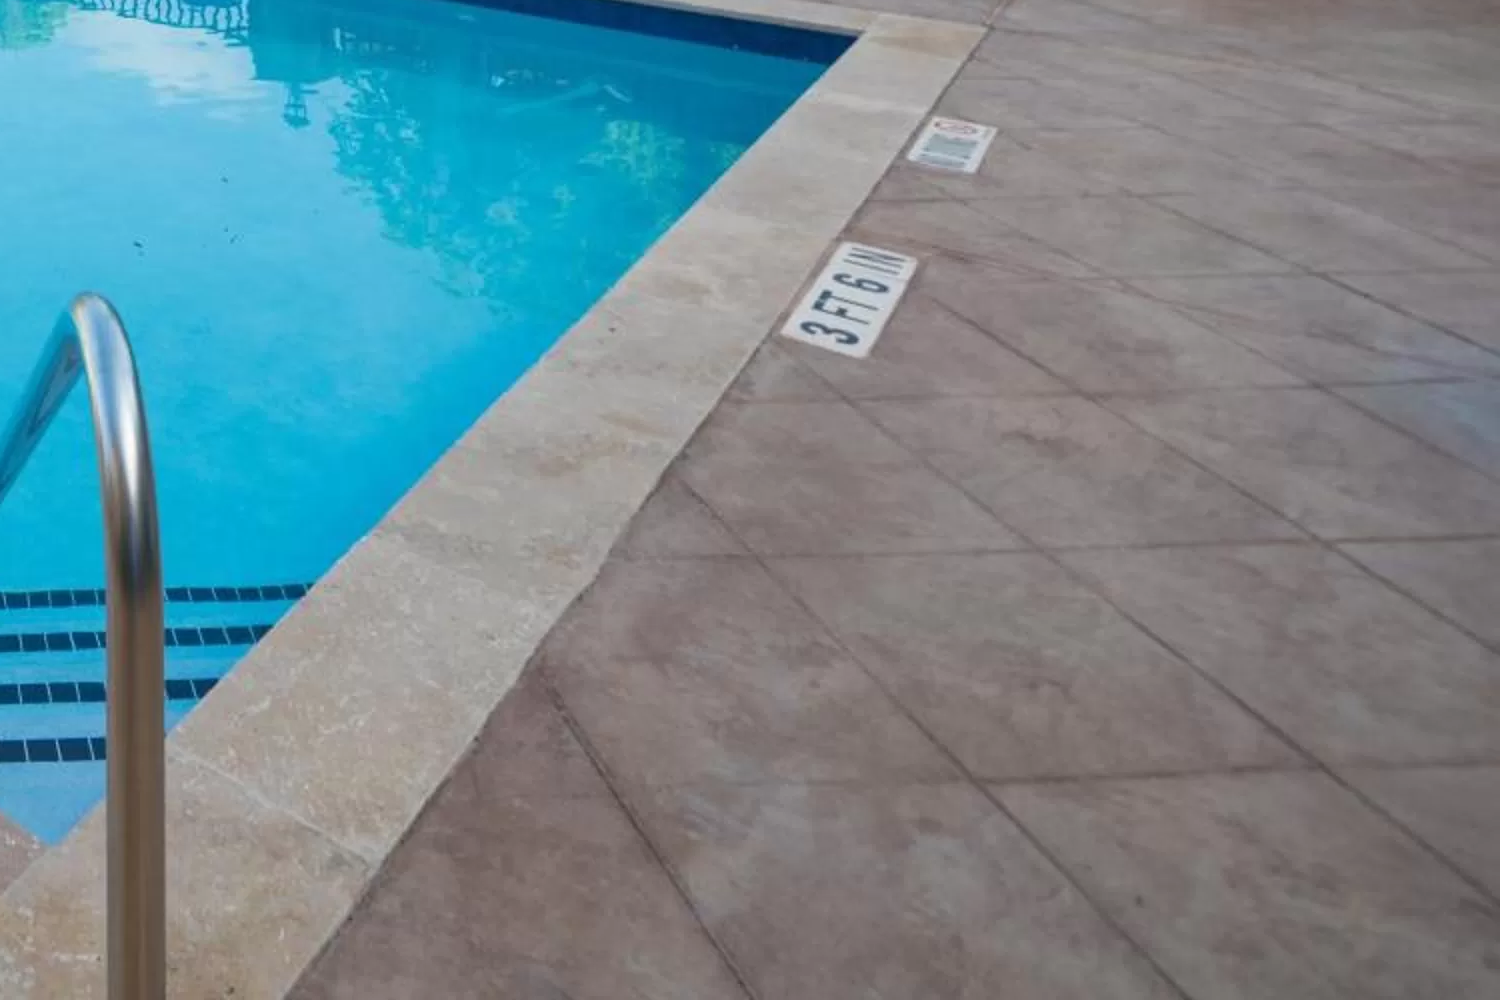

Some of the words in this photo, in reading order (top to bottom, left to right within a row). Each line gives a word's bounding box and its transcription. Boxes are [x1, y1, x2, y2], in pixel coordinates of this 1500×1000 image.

[843, 246, 908, 276] IN
[832, 272, 891, 295] 6
[811, 288, 879, 326] FT
[800, 320, 860, 346] 3
